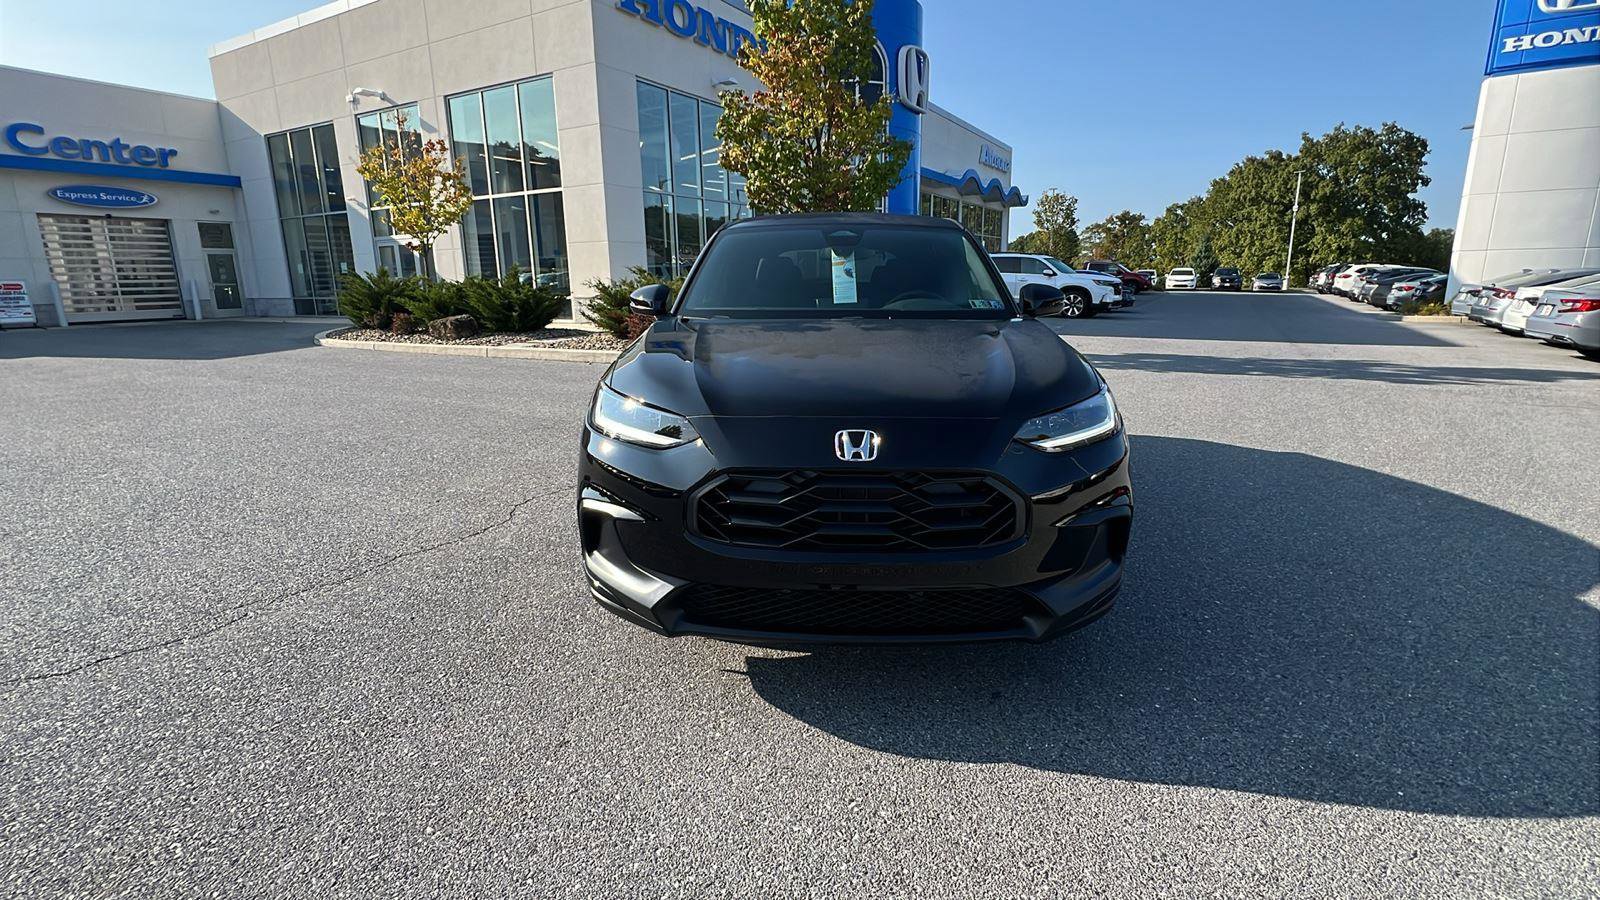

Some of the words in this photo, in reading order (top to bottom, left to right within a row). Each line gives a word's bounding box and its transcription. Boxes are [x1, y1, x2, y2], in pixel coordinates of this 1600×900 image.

[5, 122, 178, 168] Center
[56, 189, 98, 201] Express
[99, 192, 137, 203] Service
